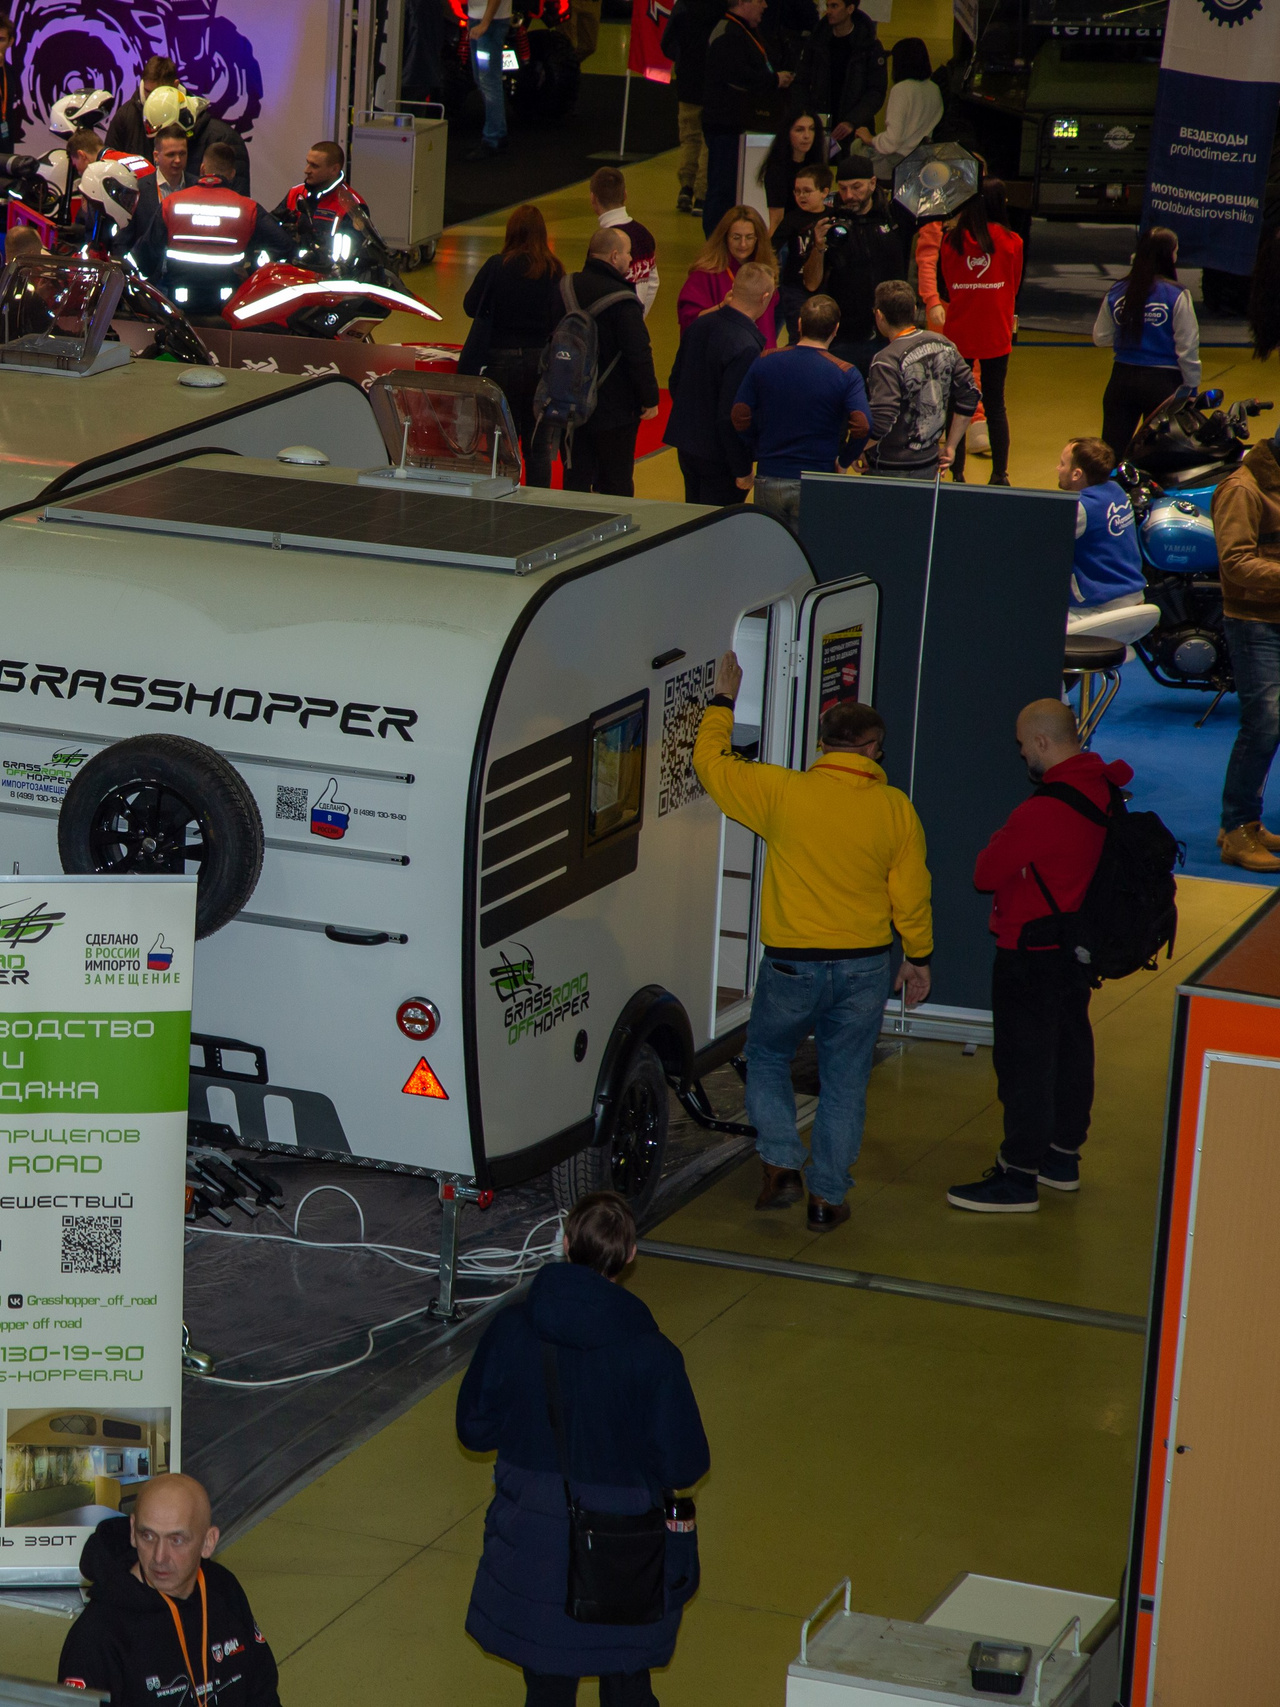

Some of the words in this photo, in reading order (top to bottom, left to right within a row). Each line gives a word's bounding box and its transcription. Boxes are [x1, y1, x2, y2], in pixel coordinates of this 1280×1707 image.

[1179, 126, 1249, 147] ВЕЗДЕХОДЫ
[1169, 142, 1257, 164] prohodimez.ru
[1163, 544, 1197, 553] YAMAHA
[2, 760, 42, 772] GRASS
[41, 767, 72, 778] ROAD
[6, 768, 28, 776] OFF
[10, 790, 15, 798] 8
[16, 791, 35, 801] (499)
[36, 794, 64, 804] 130-19-9
[318, 802, 346, 812] СДЕЛАНО
[359, 809, 376, 818] (499)
[376, 811, 407, 821] 130-19-90
[86, 934, 139, 946] СДЕЛАНО
[85, 947, 92, 959] В
[95, 947, 140, 959] РОССИИ
[85, 960, 141, 971] ИМПОРТО
[84, 972, 181, 986] ЗАМЕЩЕНИЕ
[504, 985, 553, 1028] GRASS
[551, 971, 589, 1008] ROAD
[508, 1015, 535, 1046] OFF
[533, 991, 590, 1038] HOPPER
[2, 1051, 24, 1069] И
[7, 1155, 103, 1175] ROAD
[26, 1294, 158, 1308] Grasshopper_off_road
[32, 1317, 50, 1330] off
[53, 1317, 83, 1330] road
[0, 1344, 145, 1363] 130-19-90
